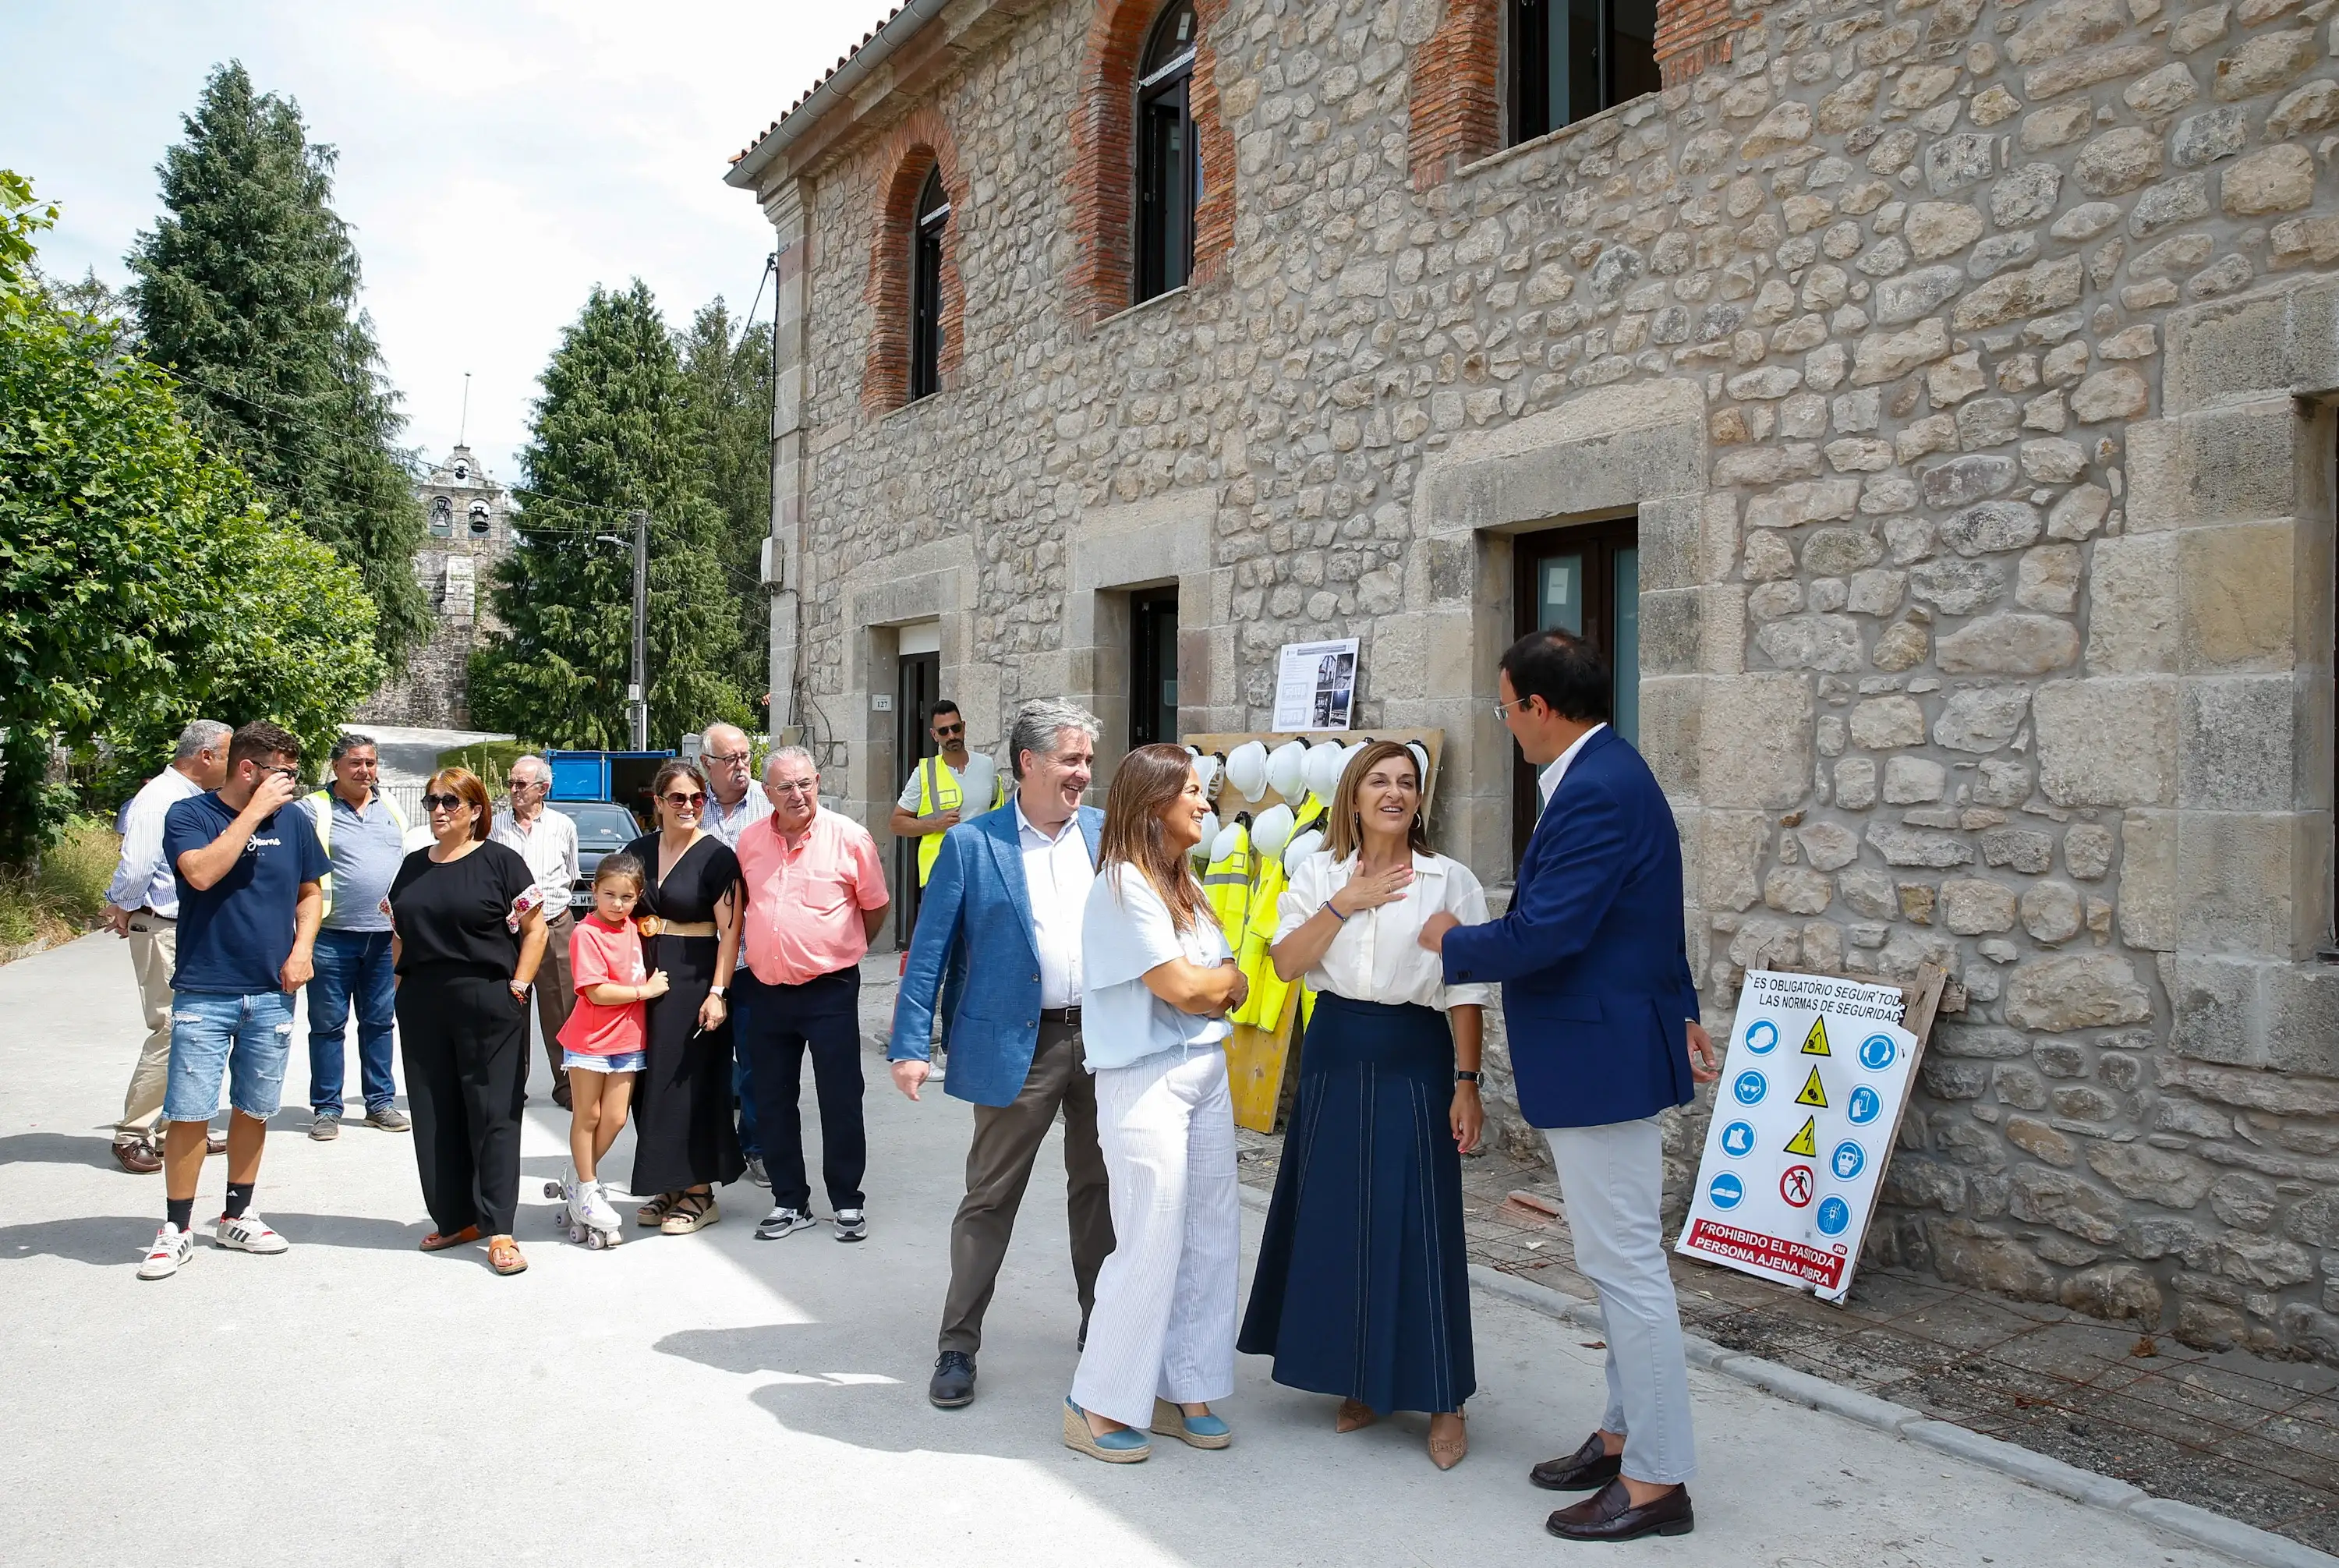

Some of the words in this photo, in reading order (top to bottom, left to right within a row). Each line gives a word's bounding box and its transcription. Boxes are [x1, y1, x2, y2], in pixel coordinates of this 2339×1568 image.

[1753, 977, 1767, 989] ES
[1770, 979, 1832, 996] OBLIGATORIO
[1835, 986, 1875, 1003] SEGUIR
[1879, 993, 1901, 1007] TOD
[1759, 993, 1780, 1007] LAS
[1782, 996, 1818, 1011] NORMAS
[1820, 1000, 1835, 1012] DE
[1836, 1002, 1900, 1022] SEGURIDAD
[1700, 1222, 1768, 1248] PROHIBIDO
[1771, 1239, 1786, 1254] EL
[1694, 1237, 1754, 1262] PERSONA
[1756, 1253, 1799, 1274] AJENA
